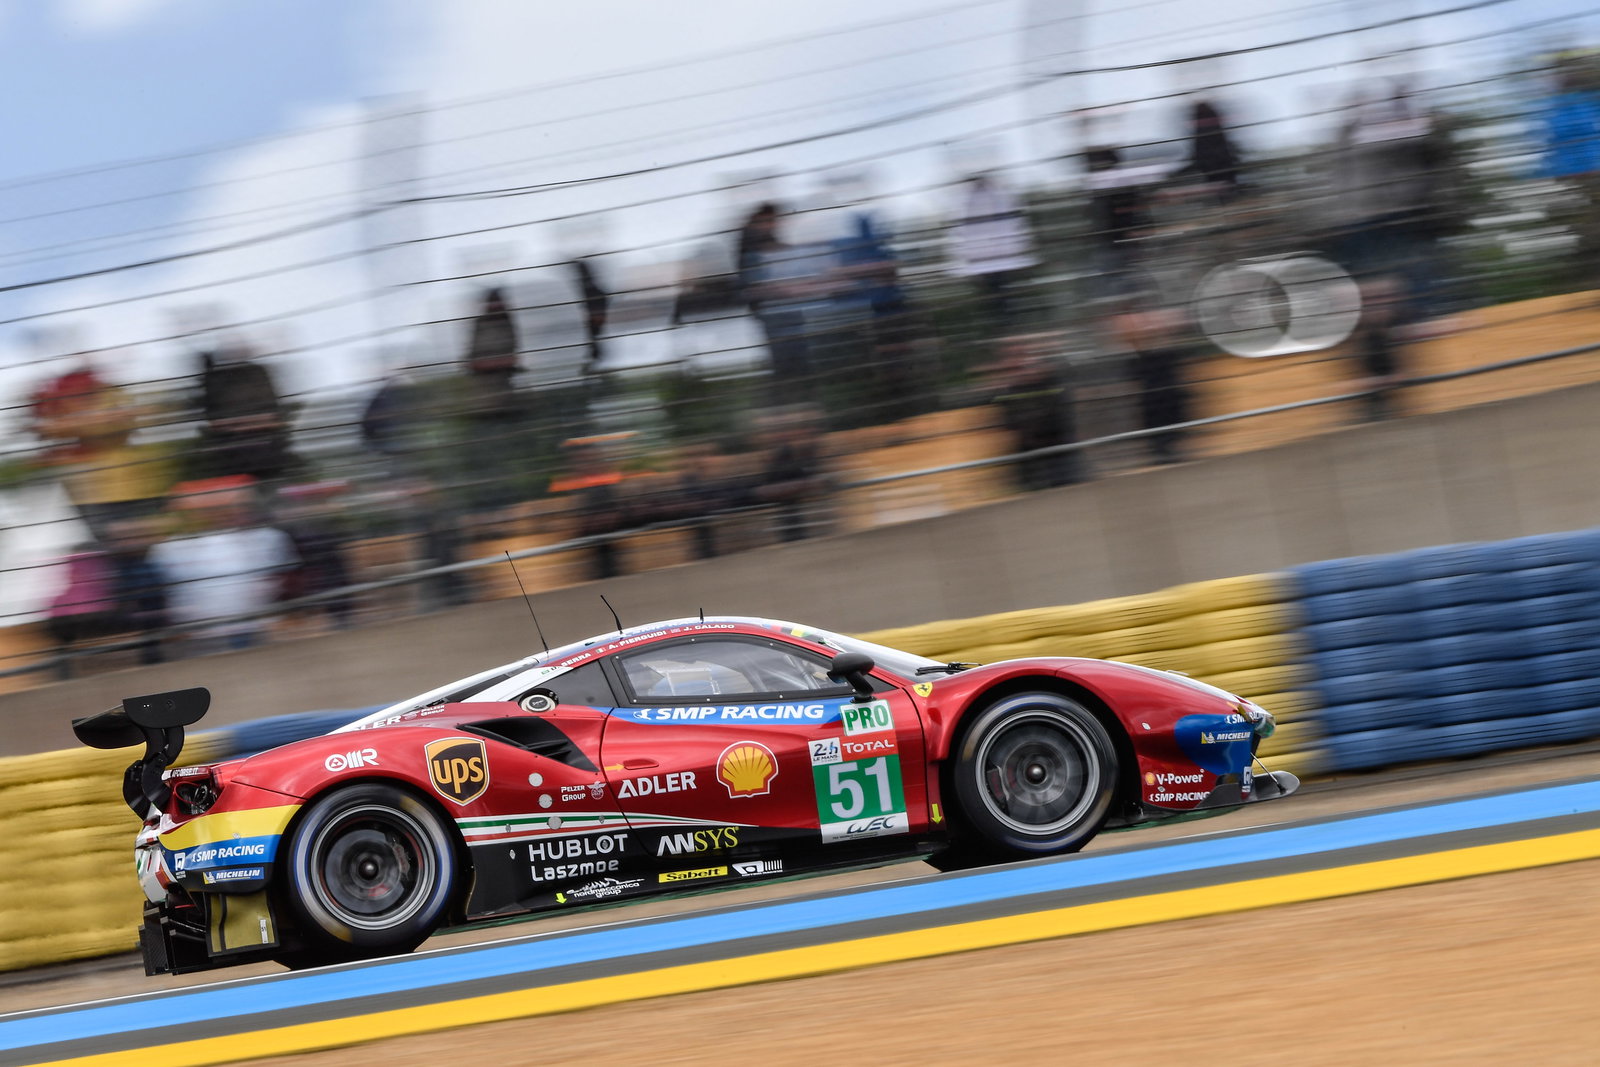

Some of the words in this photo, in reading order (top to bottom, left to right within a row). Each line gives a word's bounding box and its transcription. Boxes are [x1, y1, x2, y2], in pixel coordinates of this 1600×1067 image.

[561, 652, 592, 667] SERRA
[656, 705, 713, 720] SMP
[720, 704, 824, 720] RACING
[843, 704, 890, 732] PRO
[842, 739, 895, 754] TOTAL
[433, 756, 484, 794] ups
[1156, 772, 1204, 785] V-Power
[560, 785, 586, 794] PELZER
[618, 771, 697, 799] ADLER
[829, 756, 893, 819] 51
[561, 793, 587, 802] GROUP
[1154, 793, 1175, 802] SMP
[528, 833, 628, 862] HUBLOT
[657, 826, 737, 857] ANSYS
[197, 849, 217, 862] SMP
[218, 844, 265, 859] RACING
[216, 869, 261, 880] MICHELIN
[531, 859, 619, 882] Laszmoe
[666, 868, 722, 881] Sabelt
[595, 889, 622, 899] group
